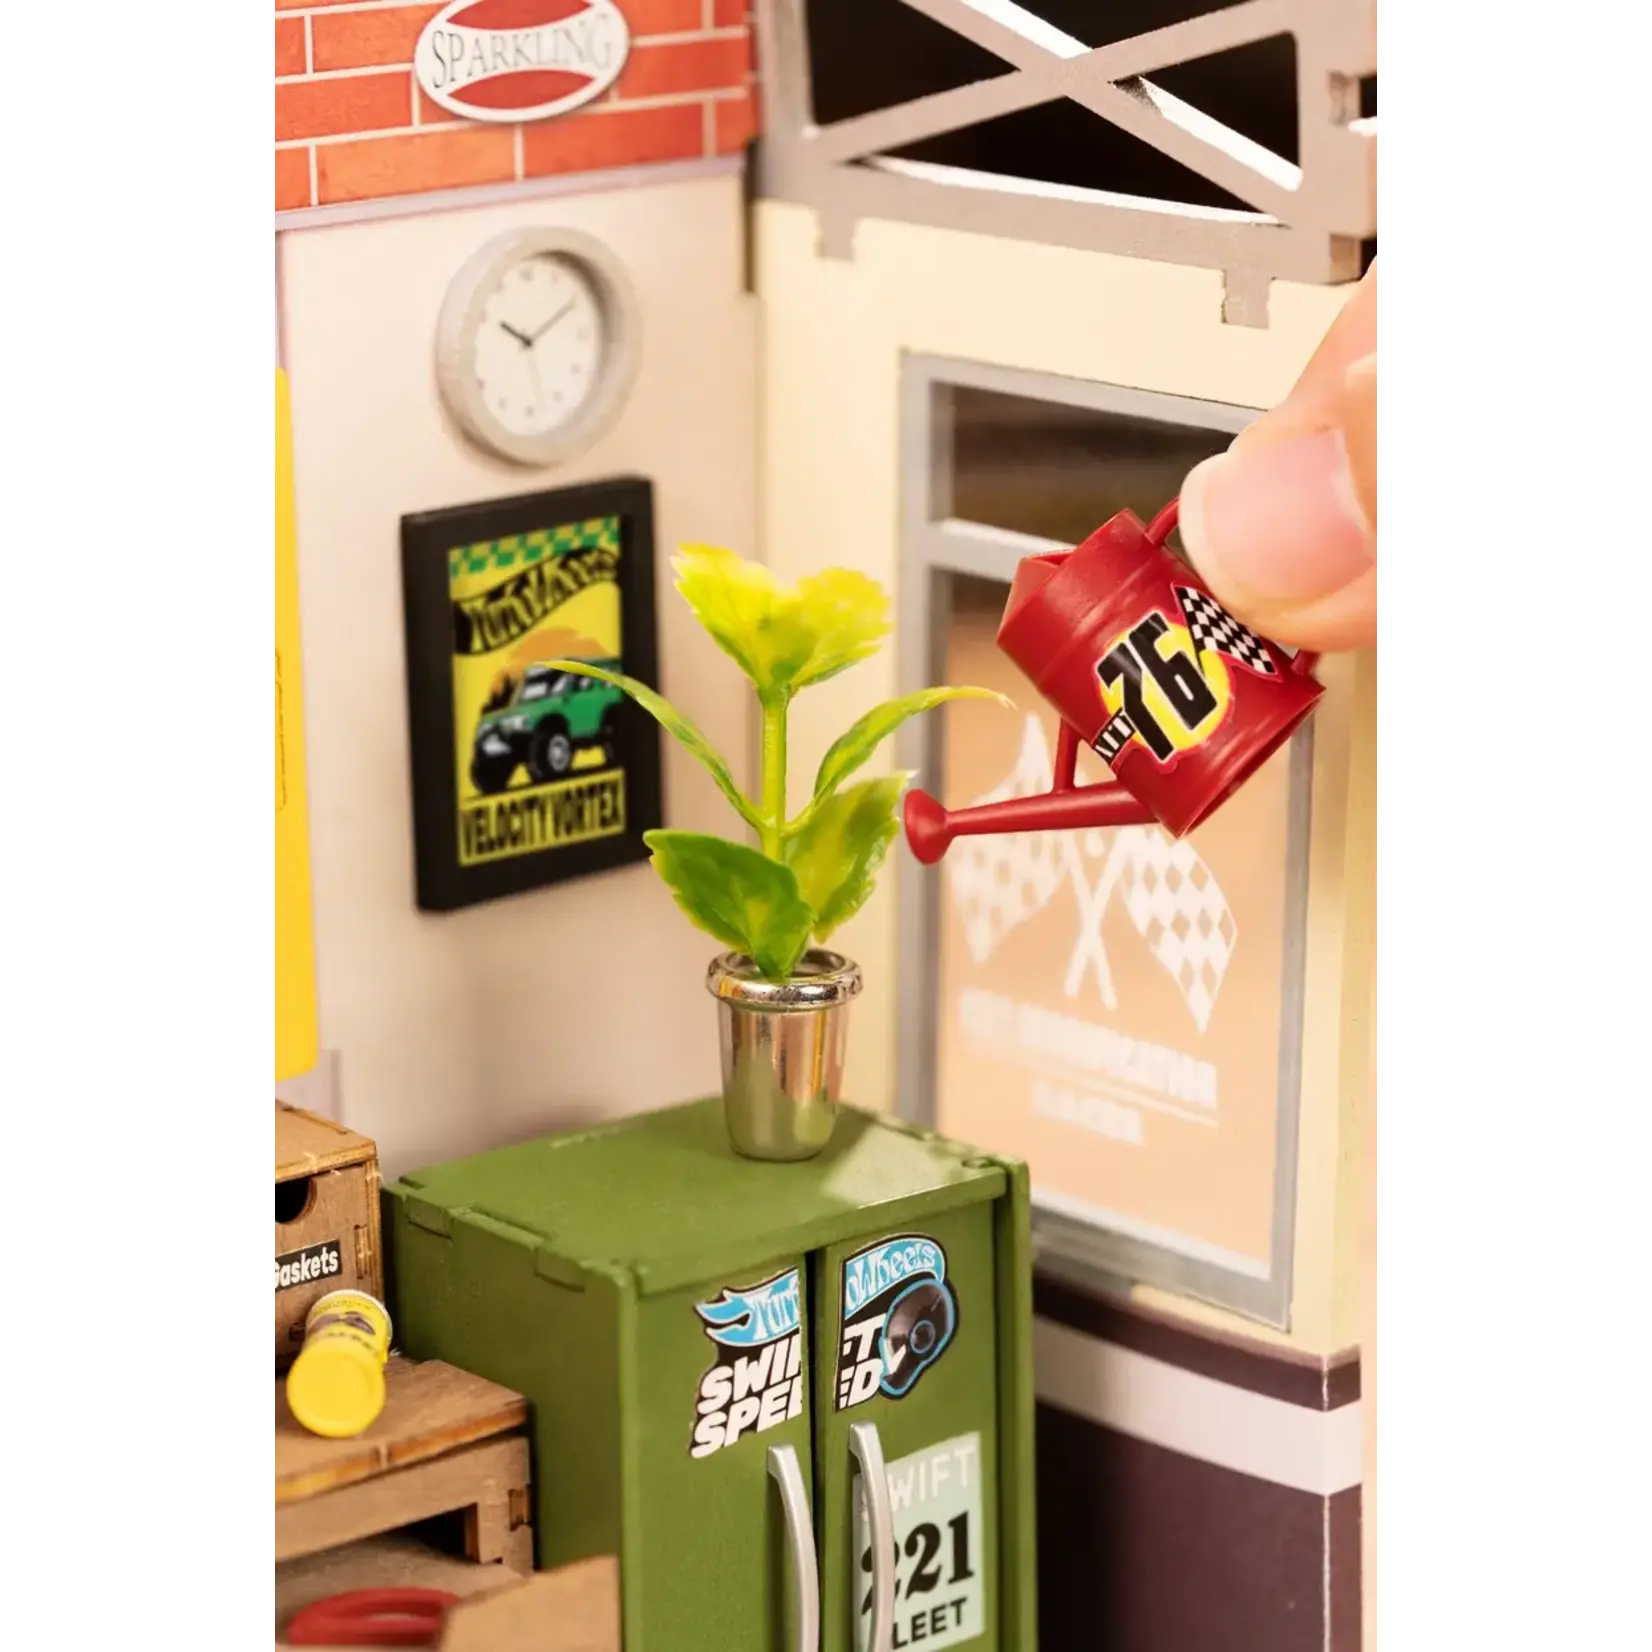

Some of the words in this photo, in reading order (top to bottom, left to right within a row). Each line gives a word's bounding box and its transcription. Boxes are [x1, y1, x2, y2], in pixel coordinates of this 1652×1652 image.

[432, 12, 612, 88] SPARKLING
[1095, 610, 1219, 763] 76
[460, 795, 550, 858] VELOCITY
[550, 779, 622, 841] VORTEX
[860, 1443, 977, 1521] WIFT
[892, 1596, 968, 1650] LEET
